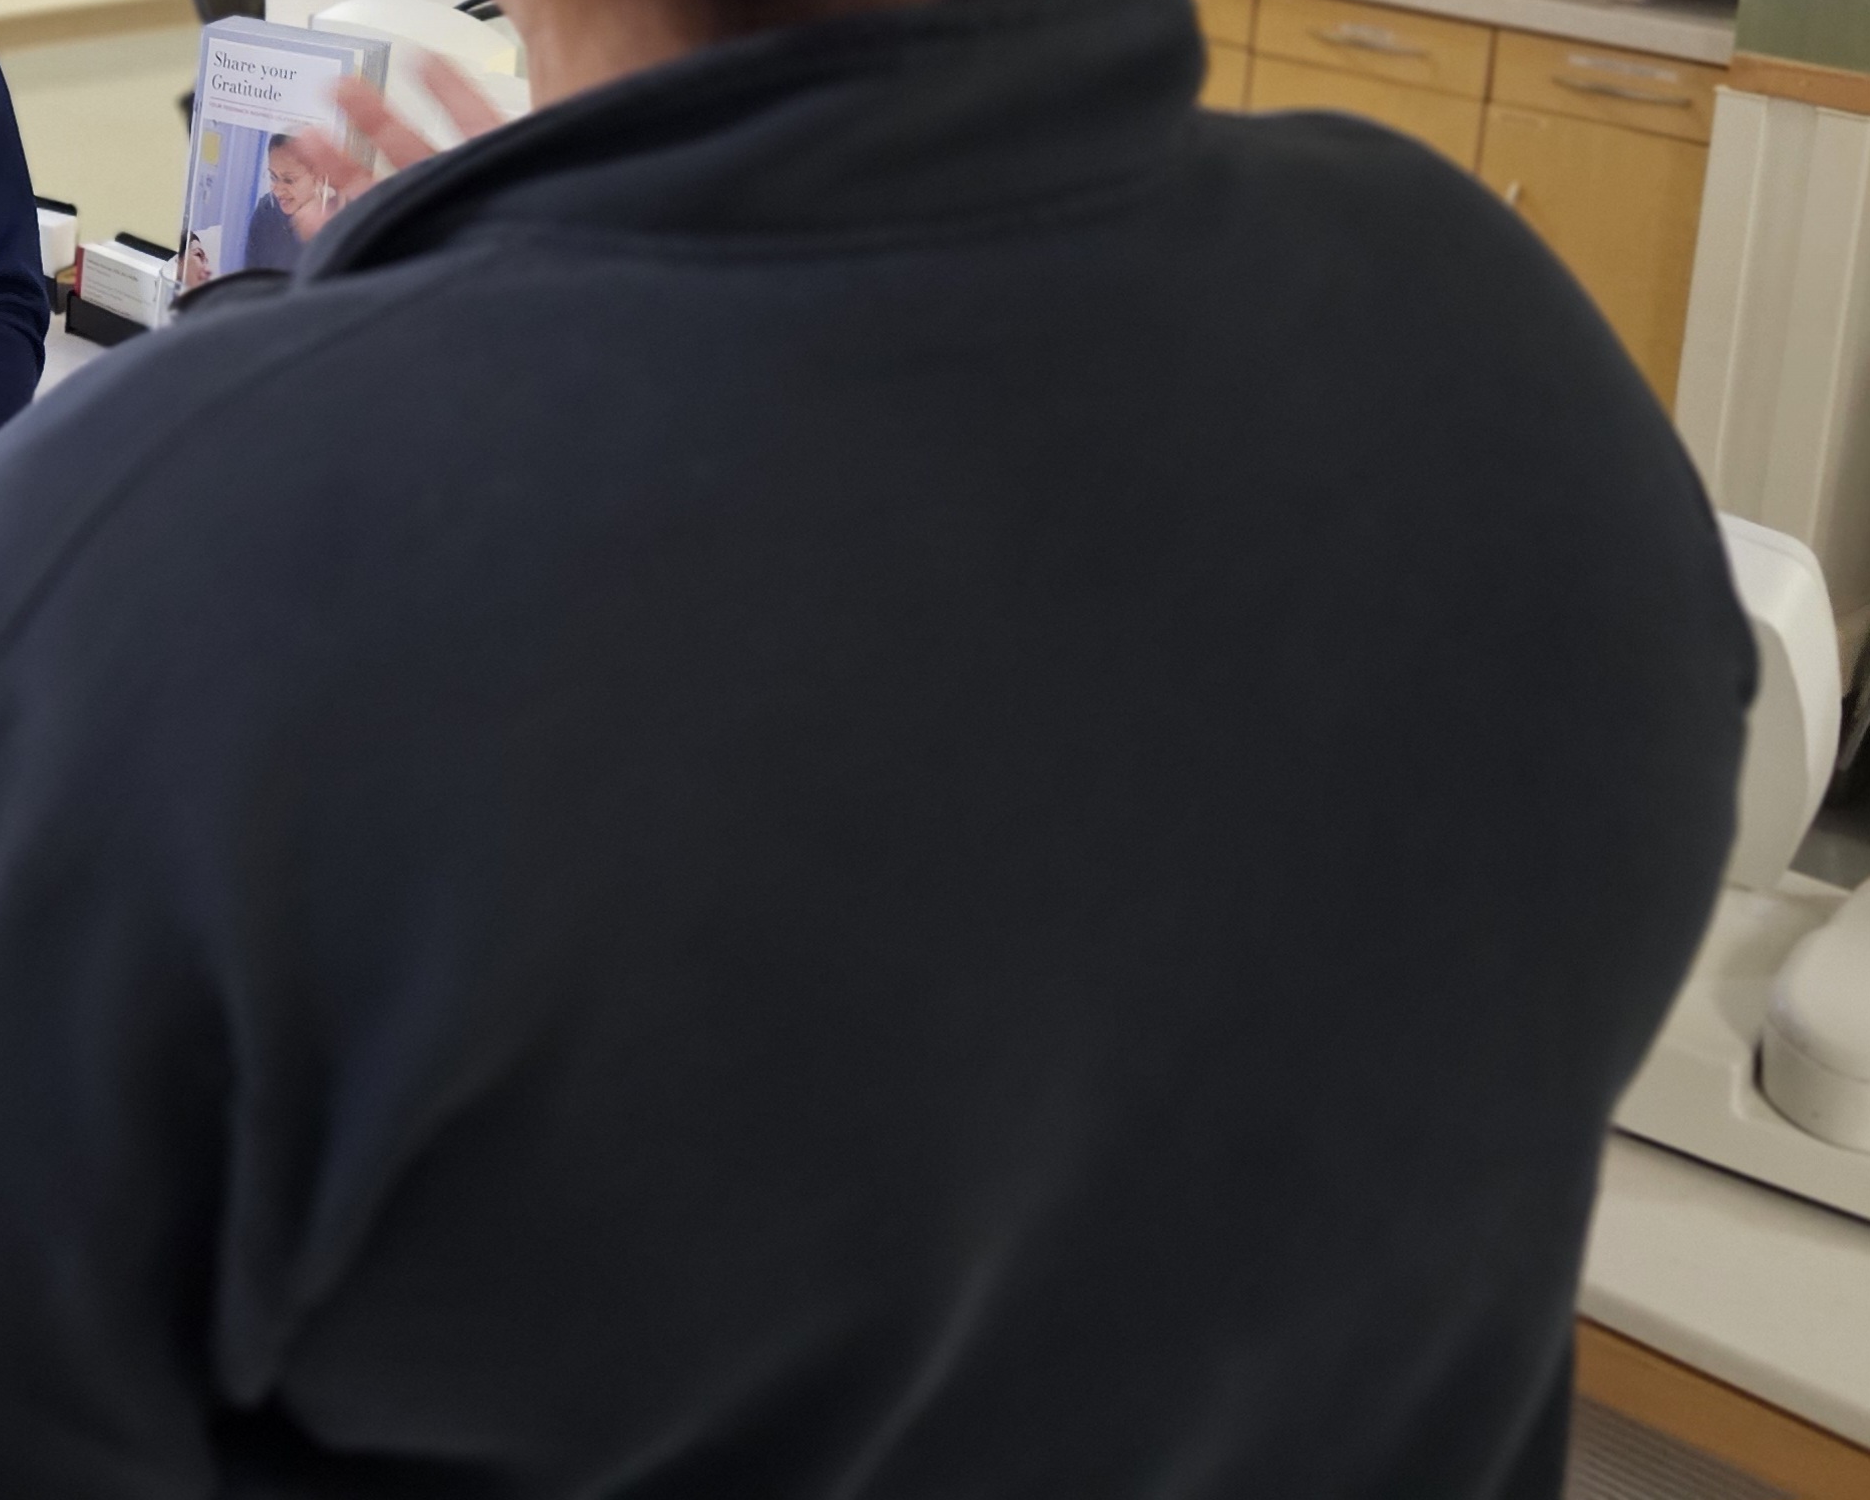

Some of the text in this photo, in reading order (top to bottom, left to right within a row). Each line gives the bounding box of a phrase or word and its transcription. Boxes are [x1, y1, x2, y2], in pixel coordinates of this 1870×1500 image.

[213, 50, 297, 80] Share your
[211, 74, 282, 102] Gratitude
